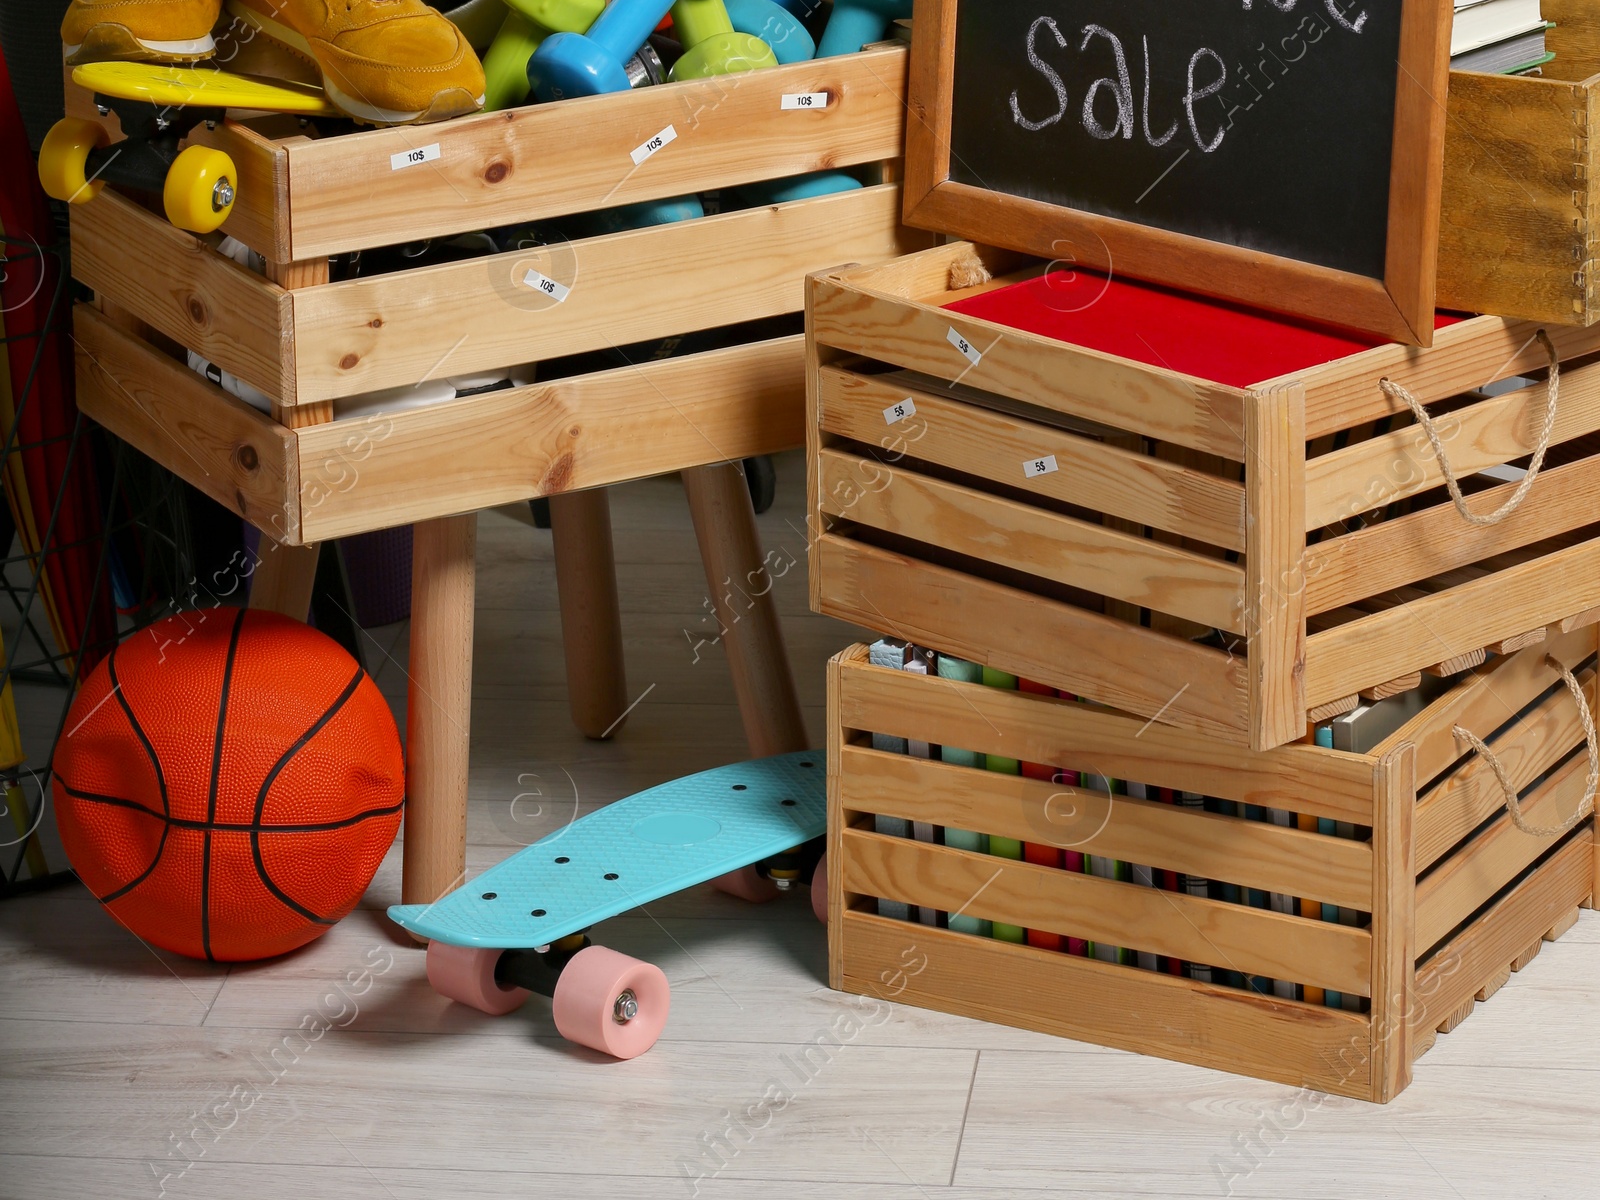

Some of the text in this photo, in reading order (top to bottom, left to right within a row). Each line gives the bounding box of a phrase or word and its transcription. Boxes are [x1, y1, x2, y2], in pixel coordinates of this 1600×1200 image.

[796, 95, 813, 106] 10$
[645, 136, 663, 152] 10$
[407, 150, 425, 163] 10$
[538, 278, 556, 294] 10$
[958, 339, 969, 354] 5$
[894, 405, 905, 417] 5$
[1035, 460, 1046, 472] 5$
